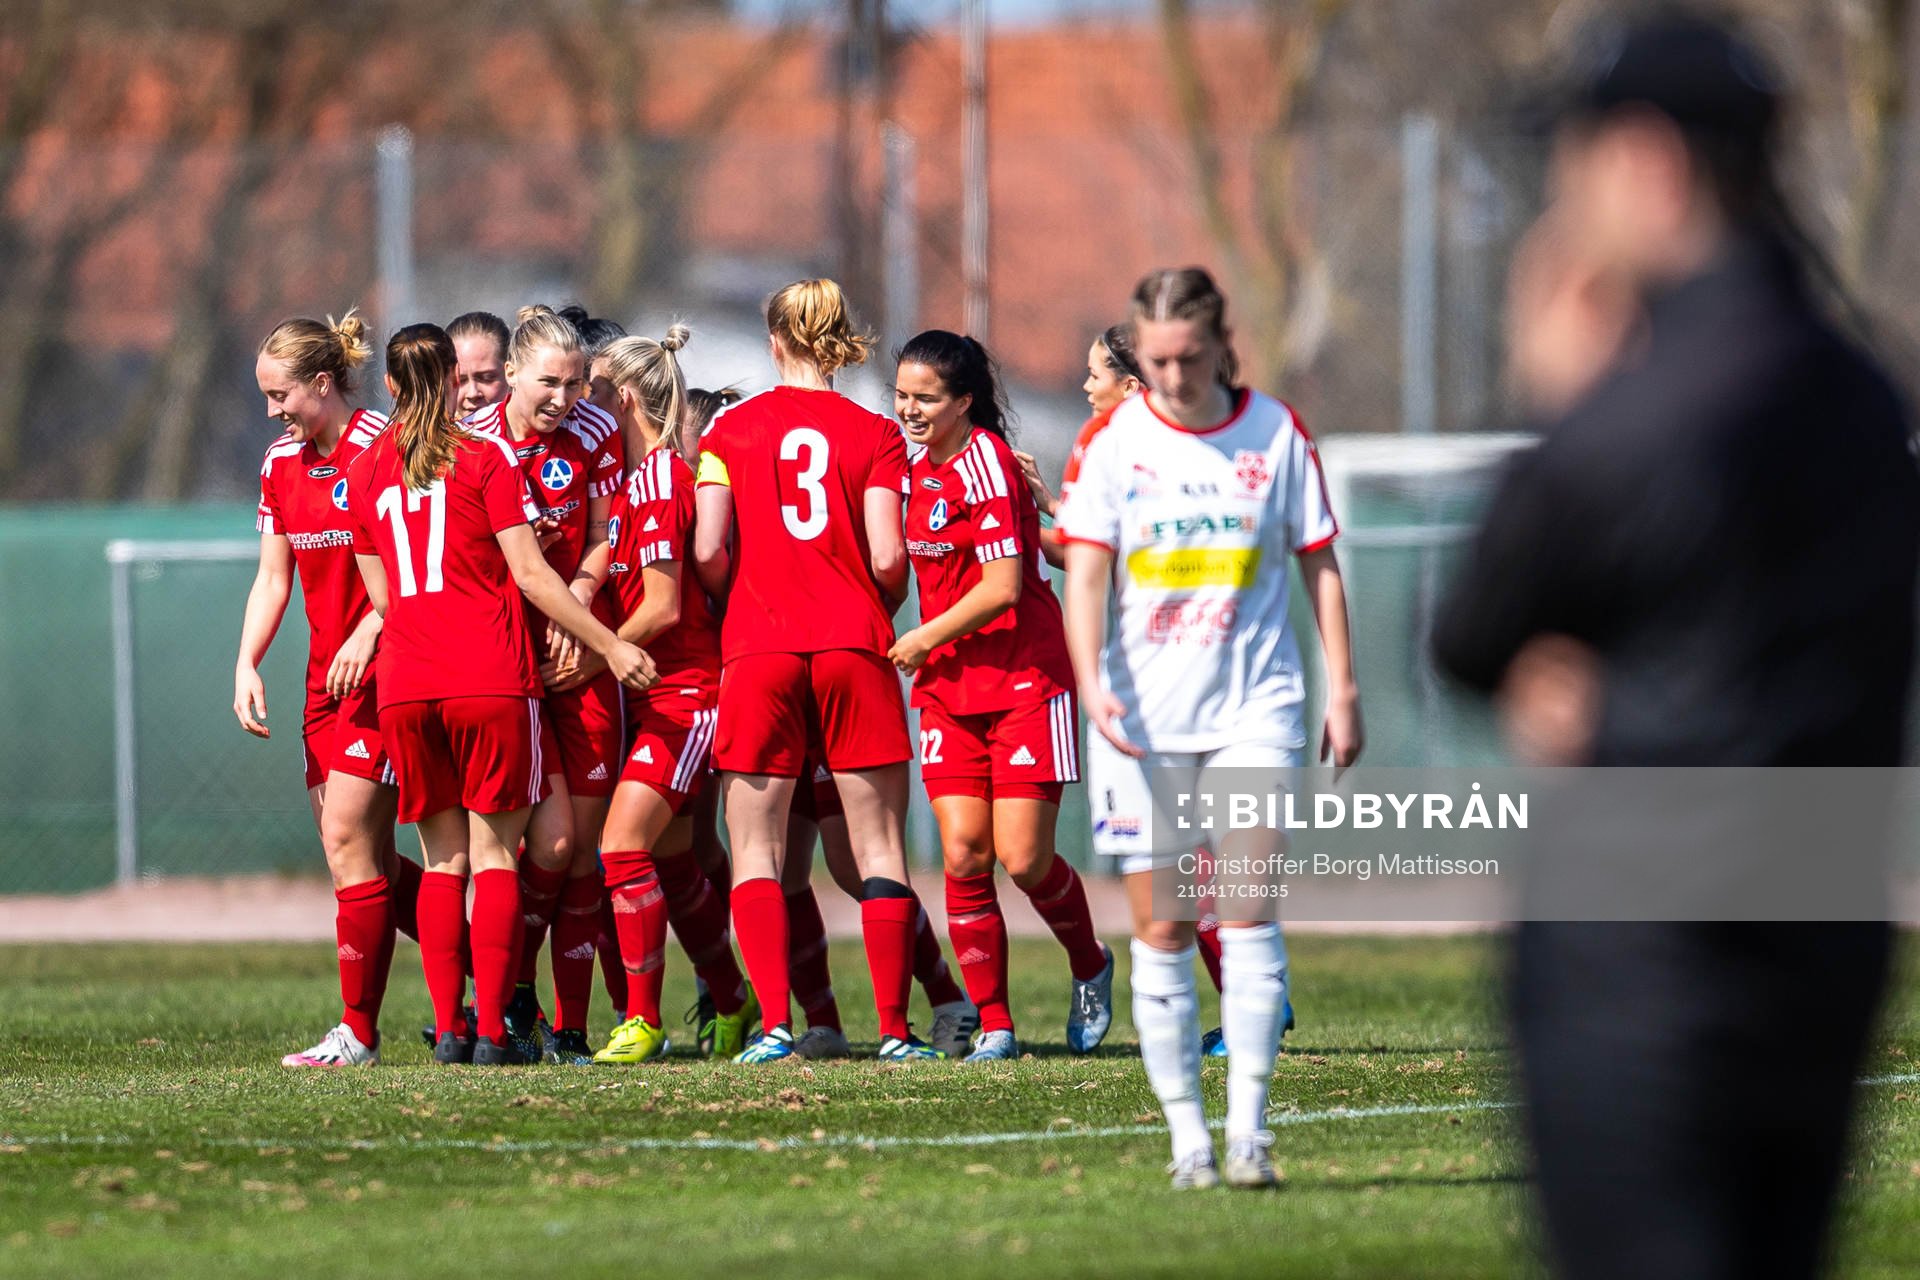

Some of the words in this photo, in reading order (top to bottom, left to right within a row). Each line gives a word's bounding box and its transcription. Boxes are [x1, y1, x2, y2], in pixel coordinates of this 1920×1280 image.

[376, 479, 446, 597] 17
[780, 427, 830, 541] 3
[920, 728, 943, 765] 22
